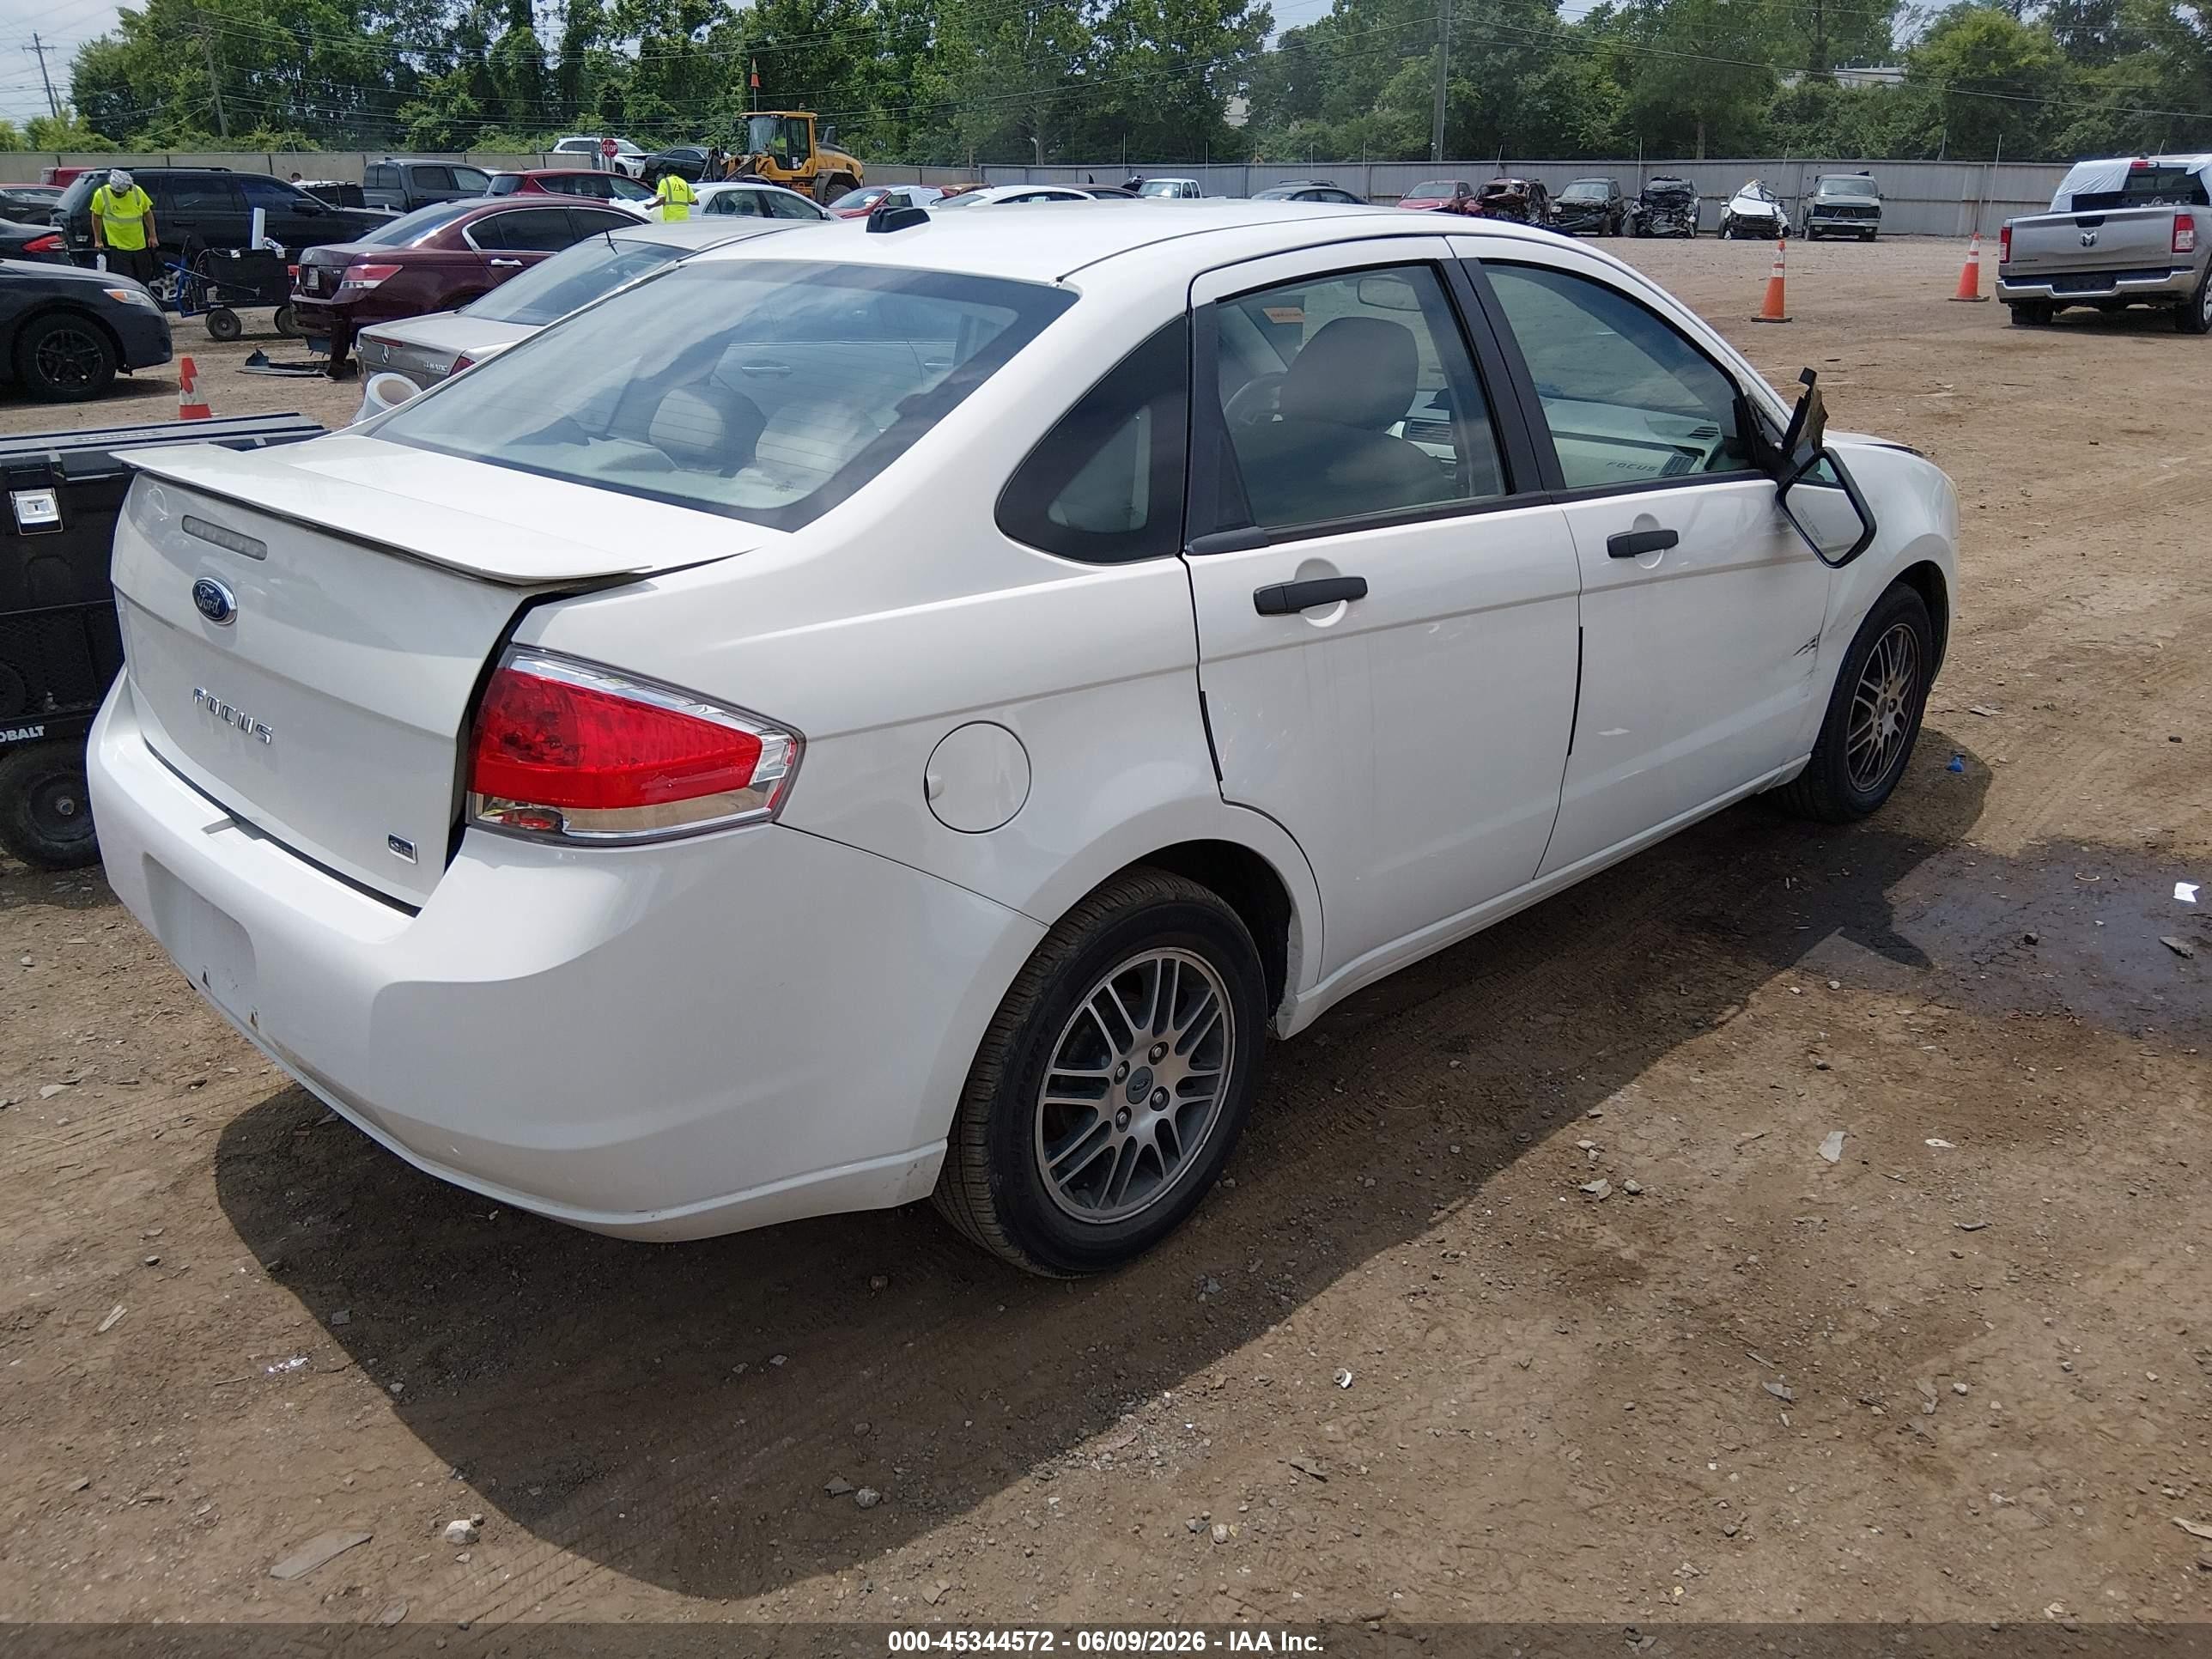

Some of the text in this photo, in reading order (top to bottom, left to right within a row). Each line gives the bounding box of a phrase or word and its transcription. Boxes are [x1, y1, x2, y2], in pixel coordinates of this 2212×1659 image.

[1607, 461, 1658, 472] FOCUS
[198, 584, 222, 615] Ford
[193, 686, 274, 745] FOCUS
